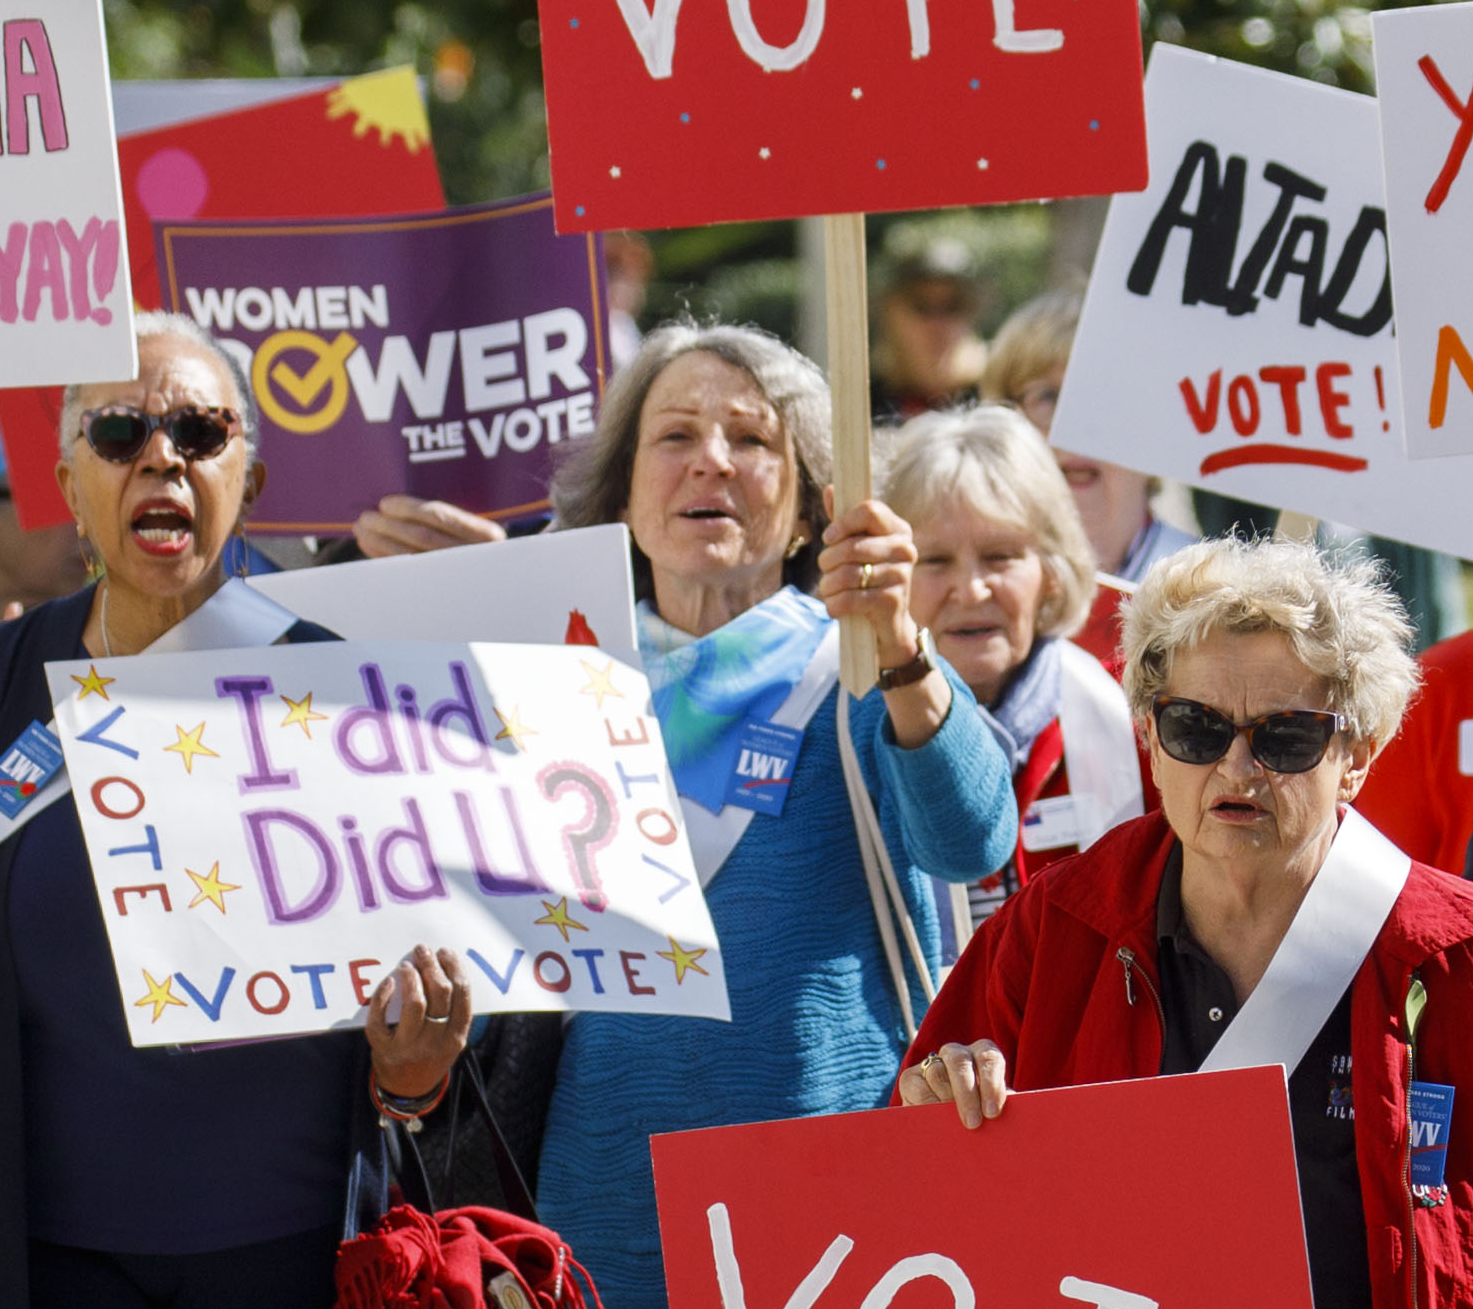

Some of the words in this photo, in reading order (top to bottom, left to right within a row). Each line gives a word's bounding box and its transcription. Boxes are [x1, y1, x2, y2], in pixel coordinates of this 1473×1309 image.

[184, 285, 391, 332] WOMEN
[401, 420, 466, 451] THE
[466, 391, 597, 459] VOTE
[215, 673, 300, 794] I
[333, 661, 496, 776] did
[0, 748, 46, 783] LWV
[735, 749, 788, 780] LWV
[74, 705, 173, 918] VOTE
[607, 716, 692, 906] VOTE
[242, 796, 449, 927] Did
[173, 959, 382, 1023] VOTE
[465, 946, 657, 996] VOTE
